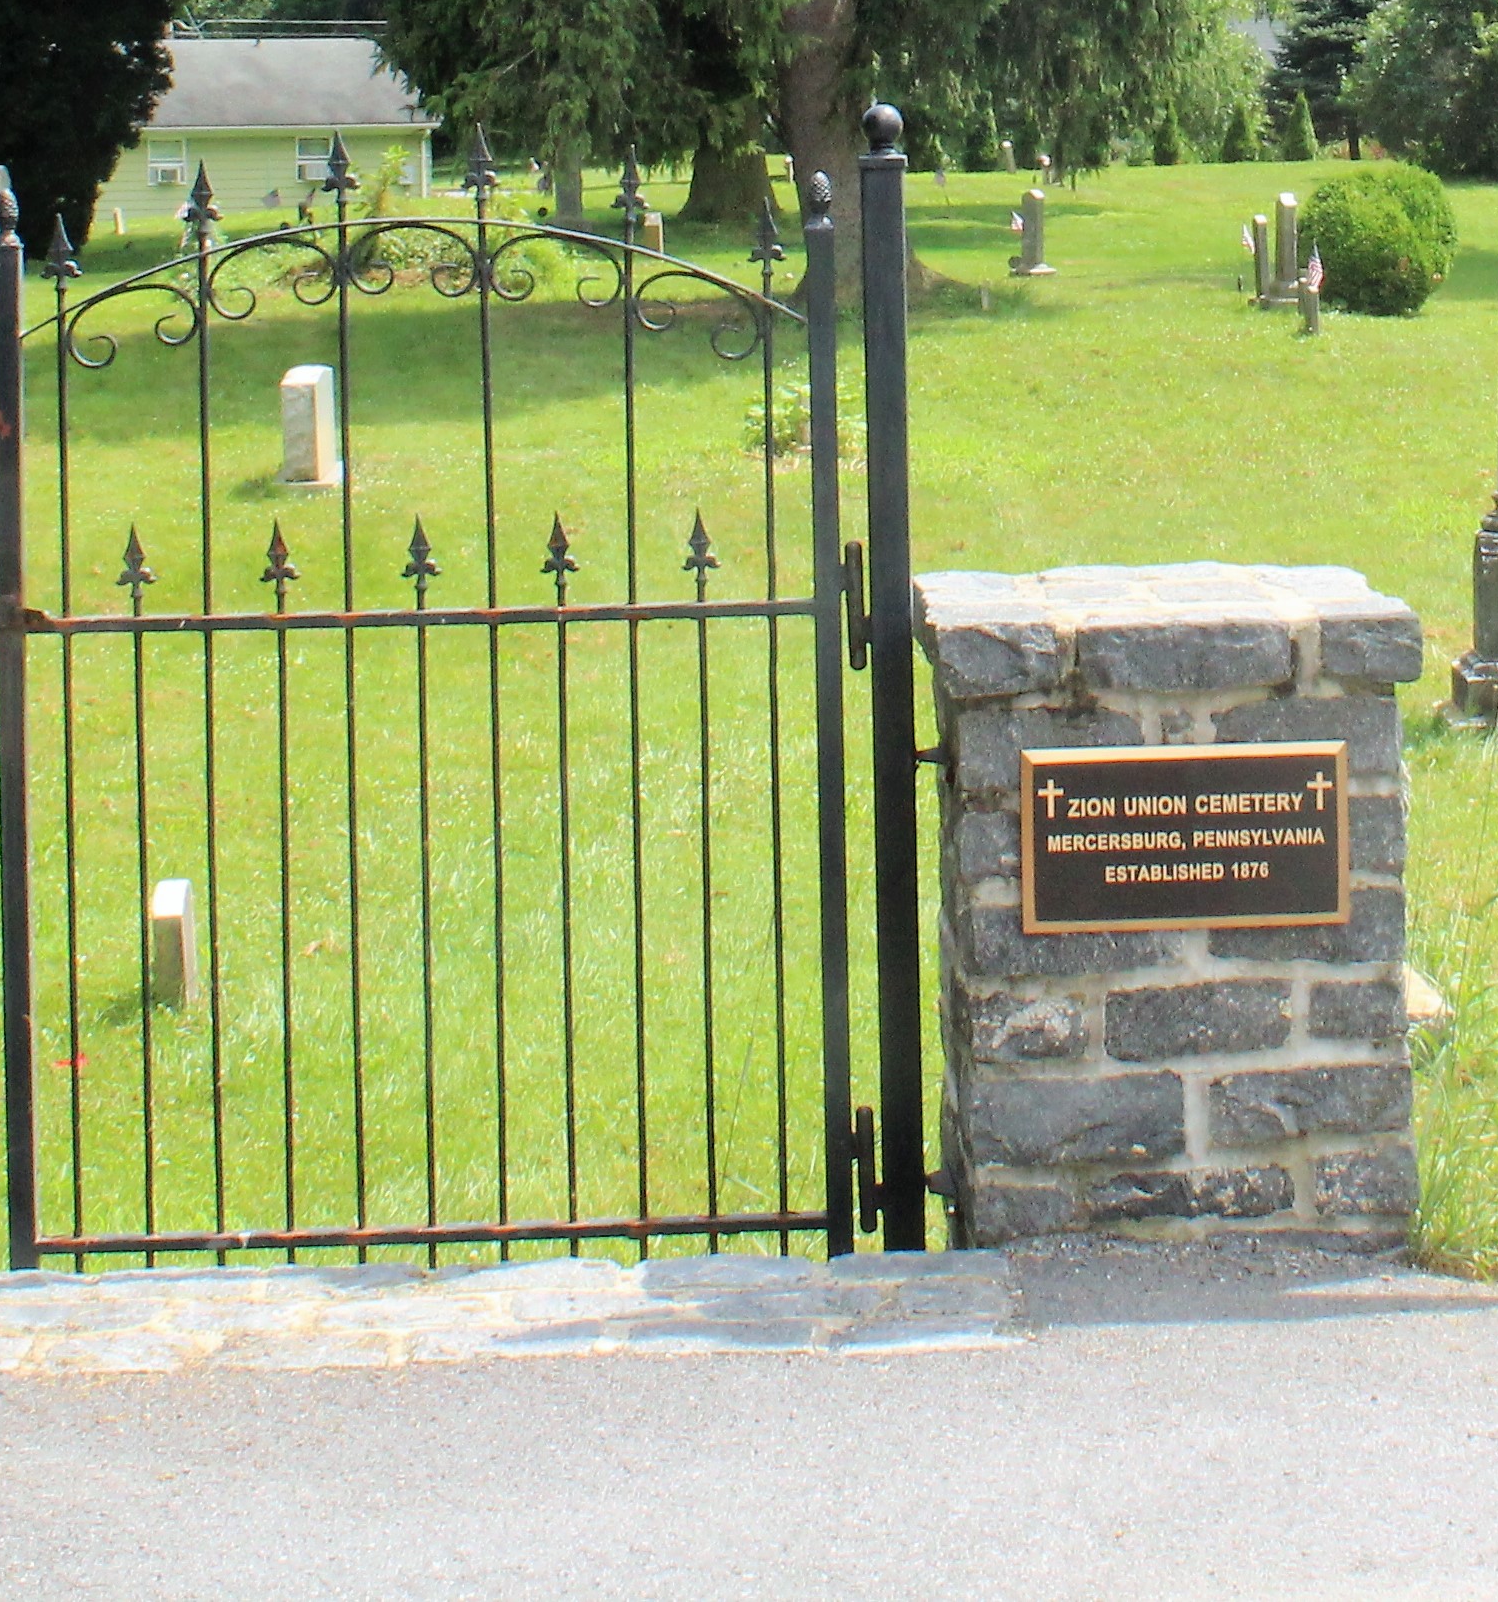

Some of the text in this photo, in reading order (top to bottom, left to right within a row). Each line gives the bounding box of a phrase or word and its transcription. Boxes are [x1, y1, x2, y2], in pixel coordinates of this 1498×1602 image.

[1067, 792, 1303, 819] ZION UNION CEMETERY
[1047, 827, 1325, 853] MERCERSBURG, PENNSYLVANIA
[1104, 861, 1270, 884] ESTABLISHED 1876
